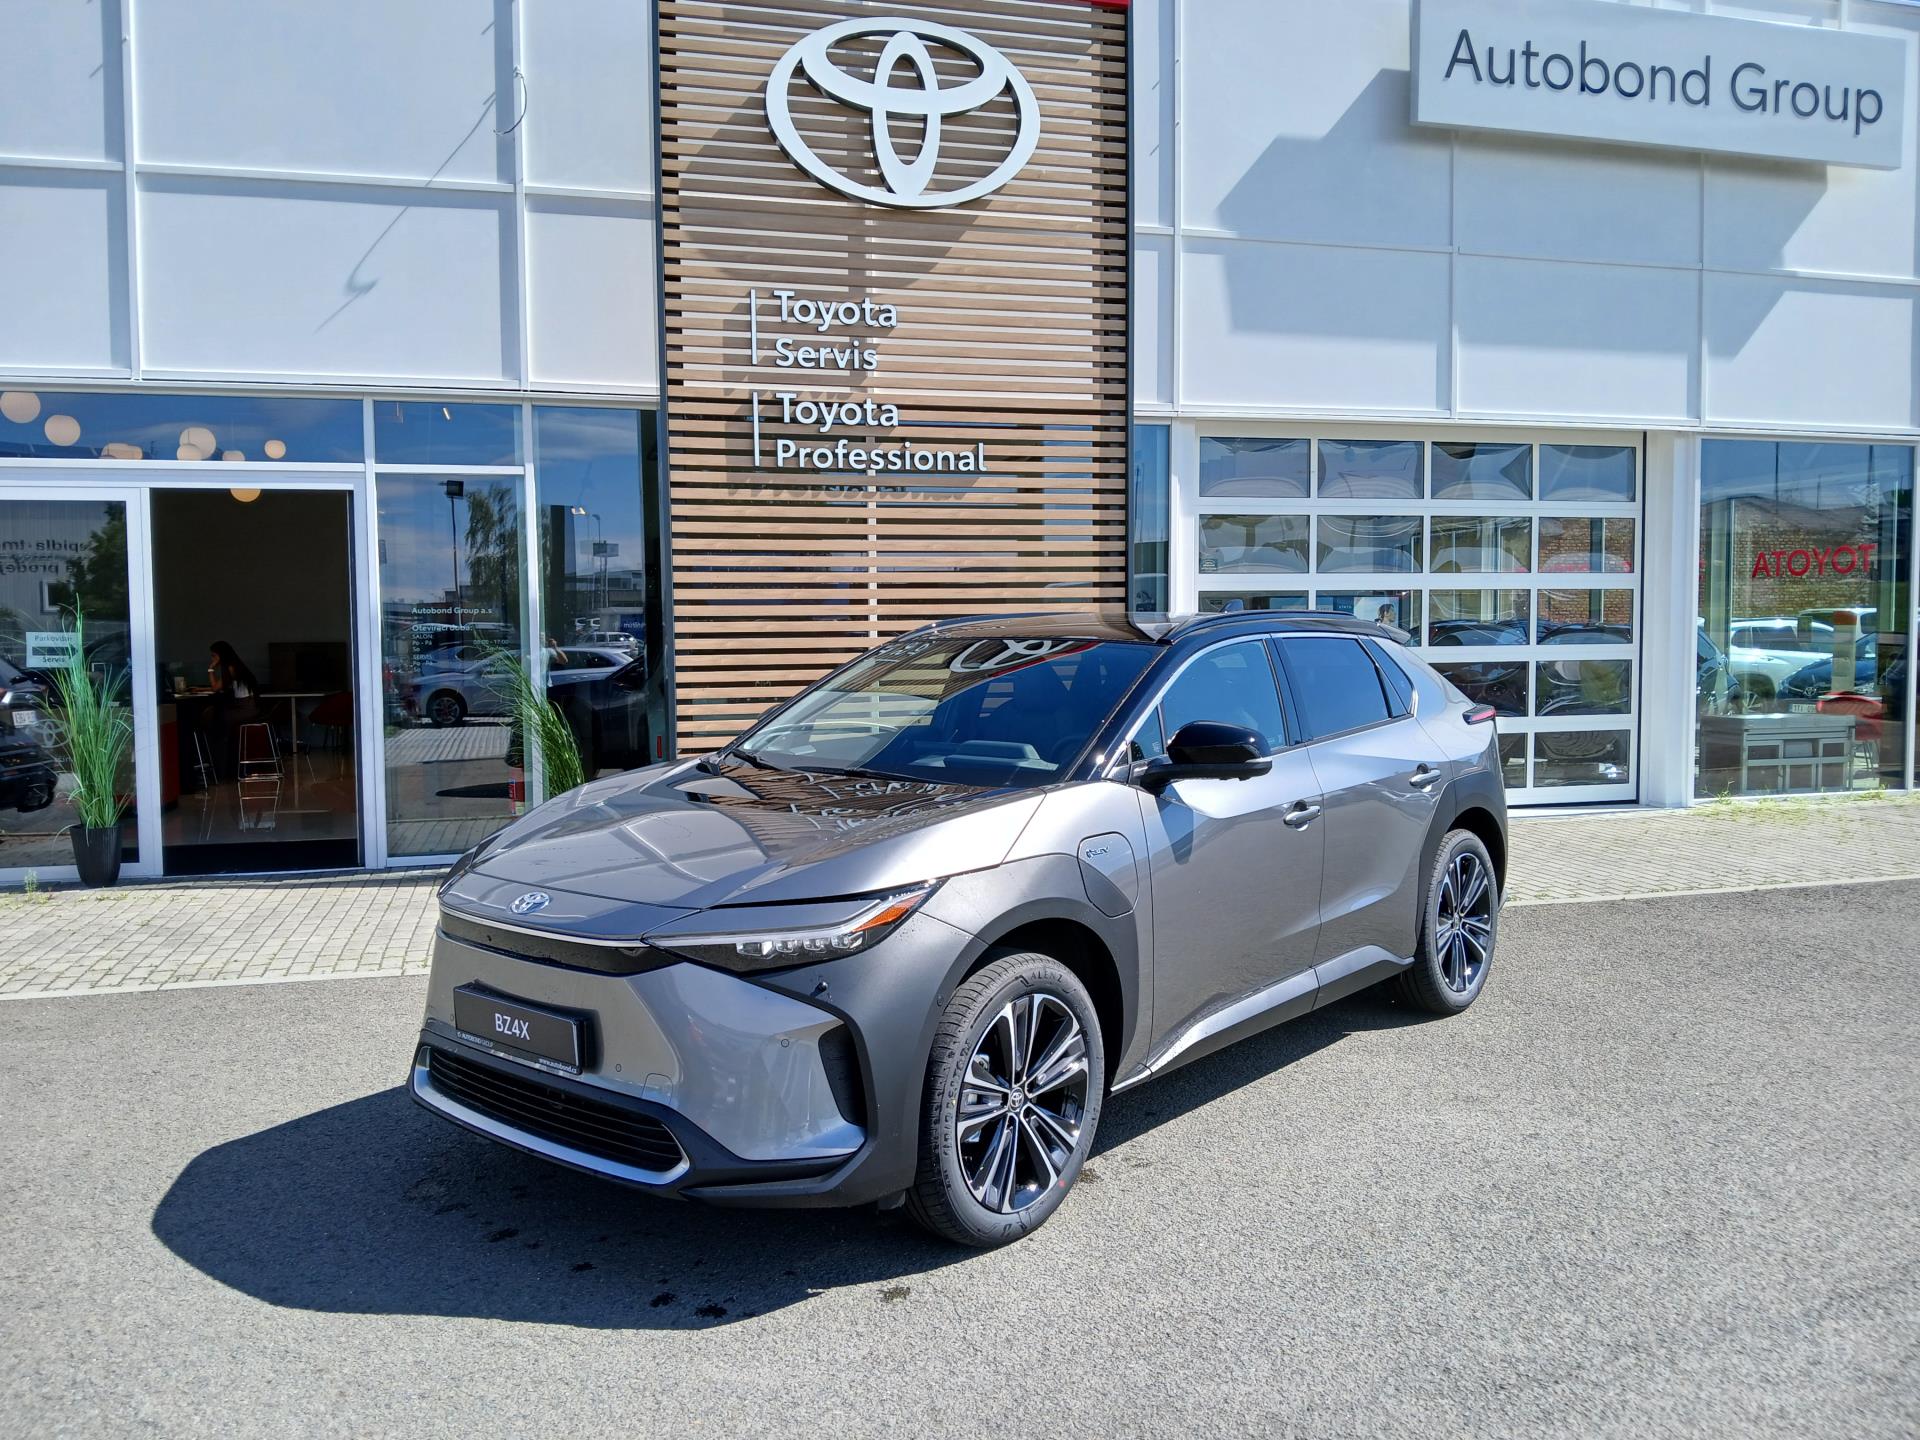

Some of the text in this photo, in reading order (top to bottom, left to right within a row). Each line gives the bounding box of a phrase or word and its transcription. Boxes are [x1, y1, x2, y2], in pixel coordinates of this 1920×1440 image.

[1444, 28, 1884, 136] Autobond Group
[773, 290, 897, 332] Toyota
[775, 338, 878, 370] Servis
[775, 392, 899, 433] Toyota
[776, 439, 987, 472] Professional
[453, 607, 480, 616] Group
[494, 1012, 531, 1041] BZ4X
